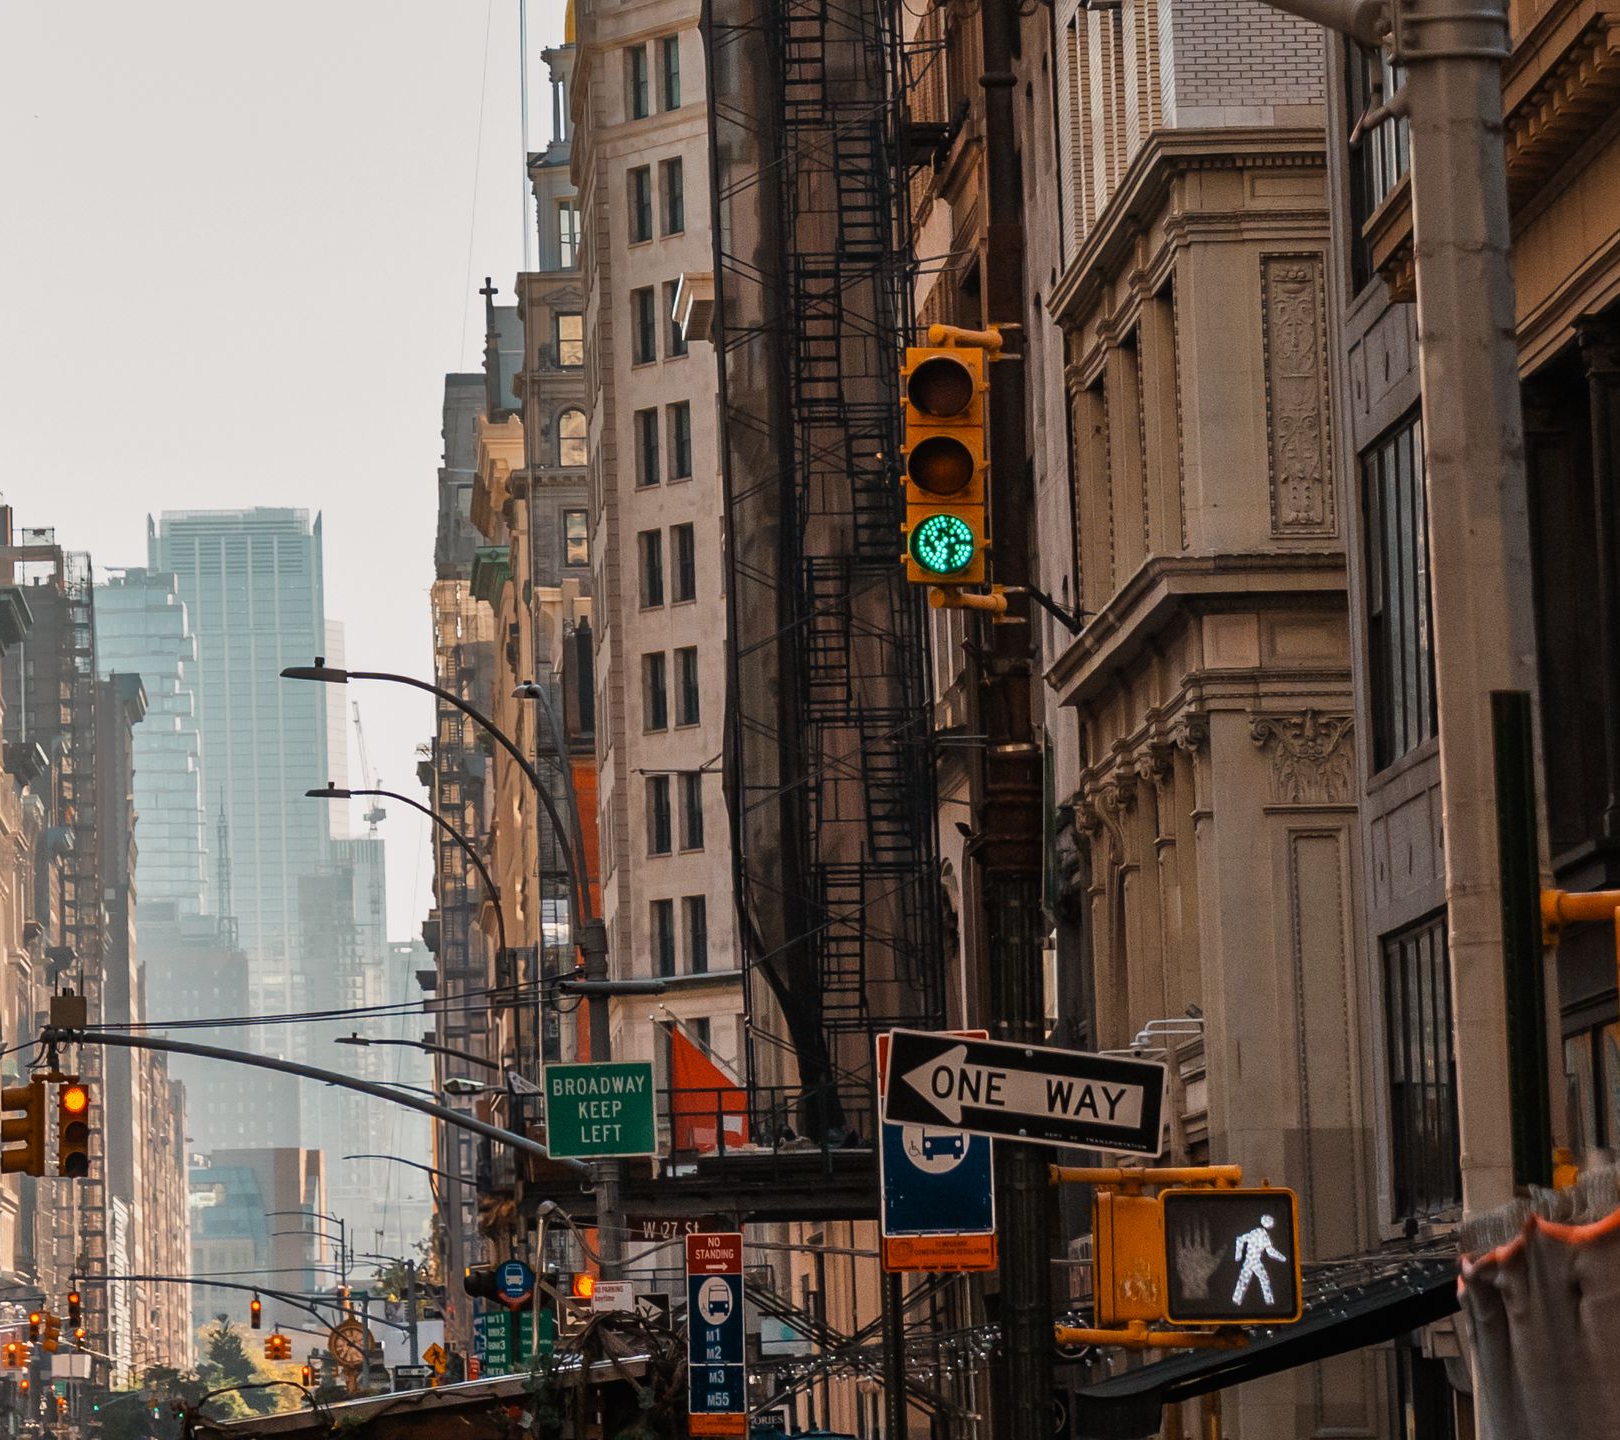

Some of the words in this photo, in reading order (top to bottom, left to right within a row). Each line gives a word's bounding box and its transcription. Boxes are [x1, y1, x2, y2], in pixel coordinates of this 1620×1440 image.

[552, 1075, 645, 1096] BROADWAY
[931, 1065, 1006, 1106] ONE
[1046, 1079, 1127, 1121] WAY
[578, 1101, 622, 1119] KEEP
[581, 1124, 622, 1143] LEFT
[643, 1221, 656, 1239] W
[662, 1221, 678, 1239] 27
[685, 1221, 699, 1235] St
[707, 1237, 721, 1247] NO
[695, 1249, 734, 1260] STANDING
[602, 1285, 624, 1293] PARKING
[706, 1330, 721, 1342] M1
[707, 1347, 722, 1360] M2
[709, 1370, 725, 1384] M3
[707, 1393, 730, 1407] M55
